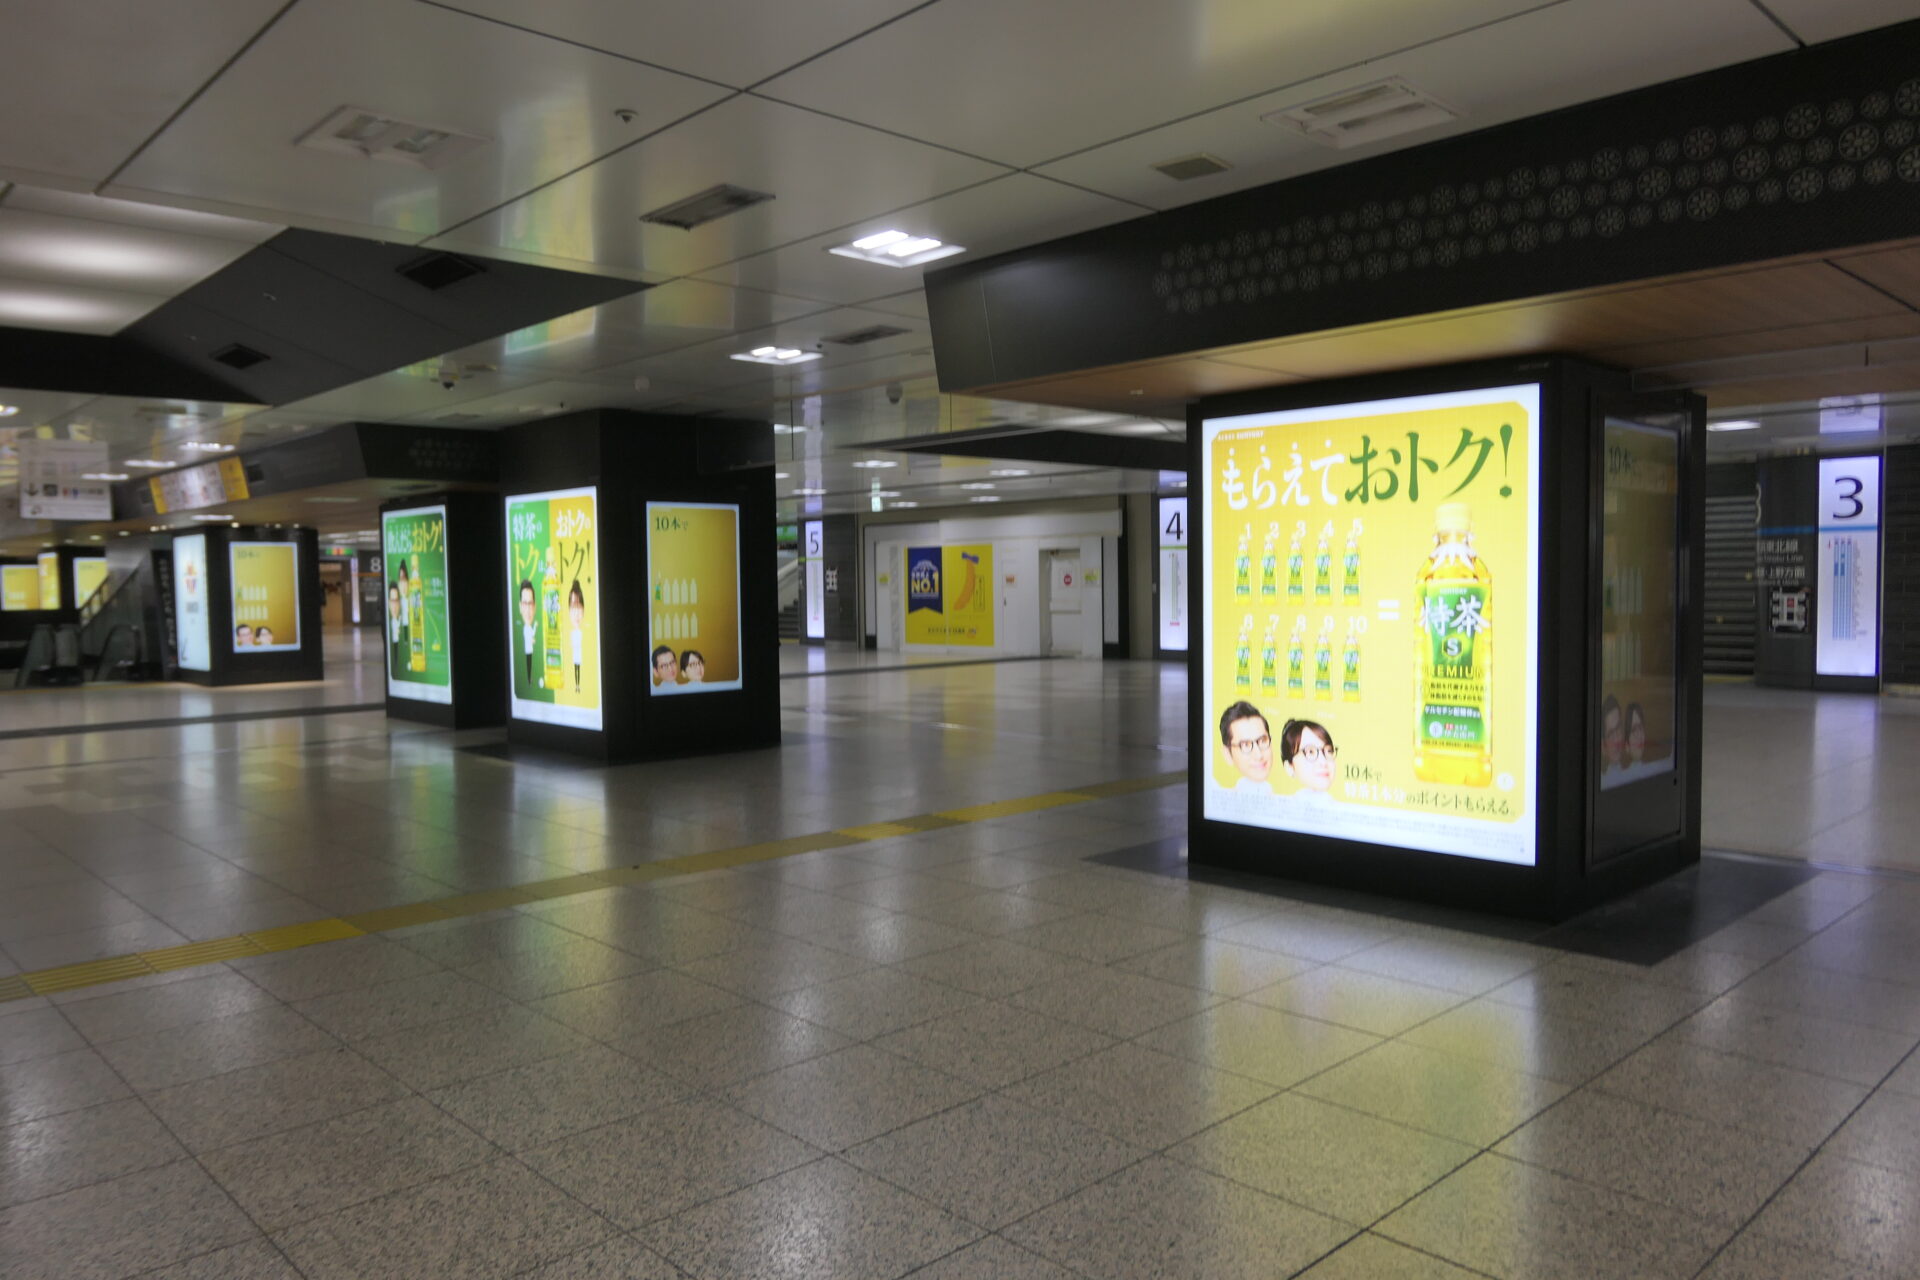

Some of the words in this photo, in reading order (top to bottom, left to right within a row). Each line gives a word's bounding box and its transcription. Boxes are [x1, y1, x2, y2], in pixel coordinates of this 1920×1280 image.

[1832, 476, 1864, 520] 3
[1165, 511, 1184, 541] 4
[1245, 522, 1252, 540] 1
[1270, 522, 1280, 539] 2
[1297, 520, 1307, 538] 3
[1325, 519, 1335, 537] 4
[1353, 518, 1363, 536] 5
[809, 531, 819, 555] 5
[370, 556, 381, 573] 8
[1270, 614, 1280, 632] 7
[1297, 614, 1307, 632] 8
[1324, 615, 1335, 632] 9
[1349, 615, 1368, 633] 10
[1419, 594, 1490, 638] 特茶
[1446, 637, 1459, 656] S
